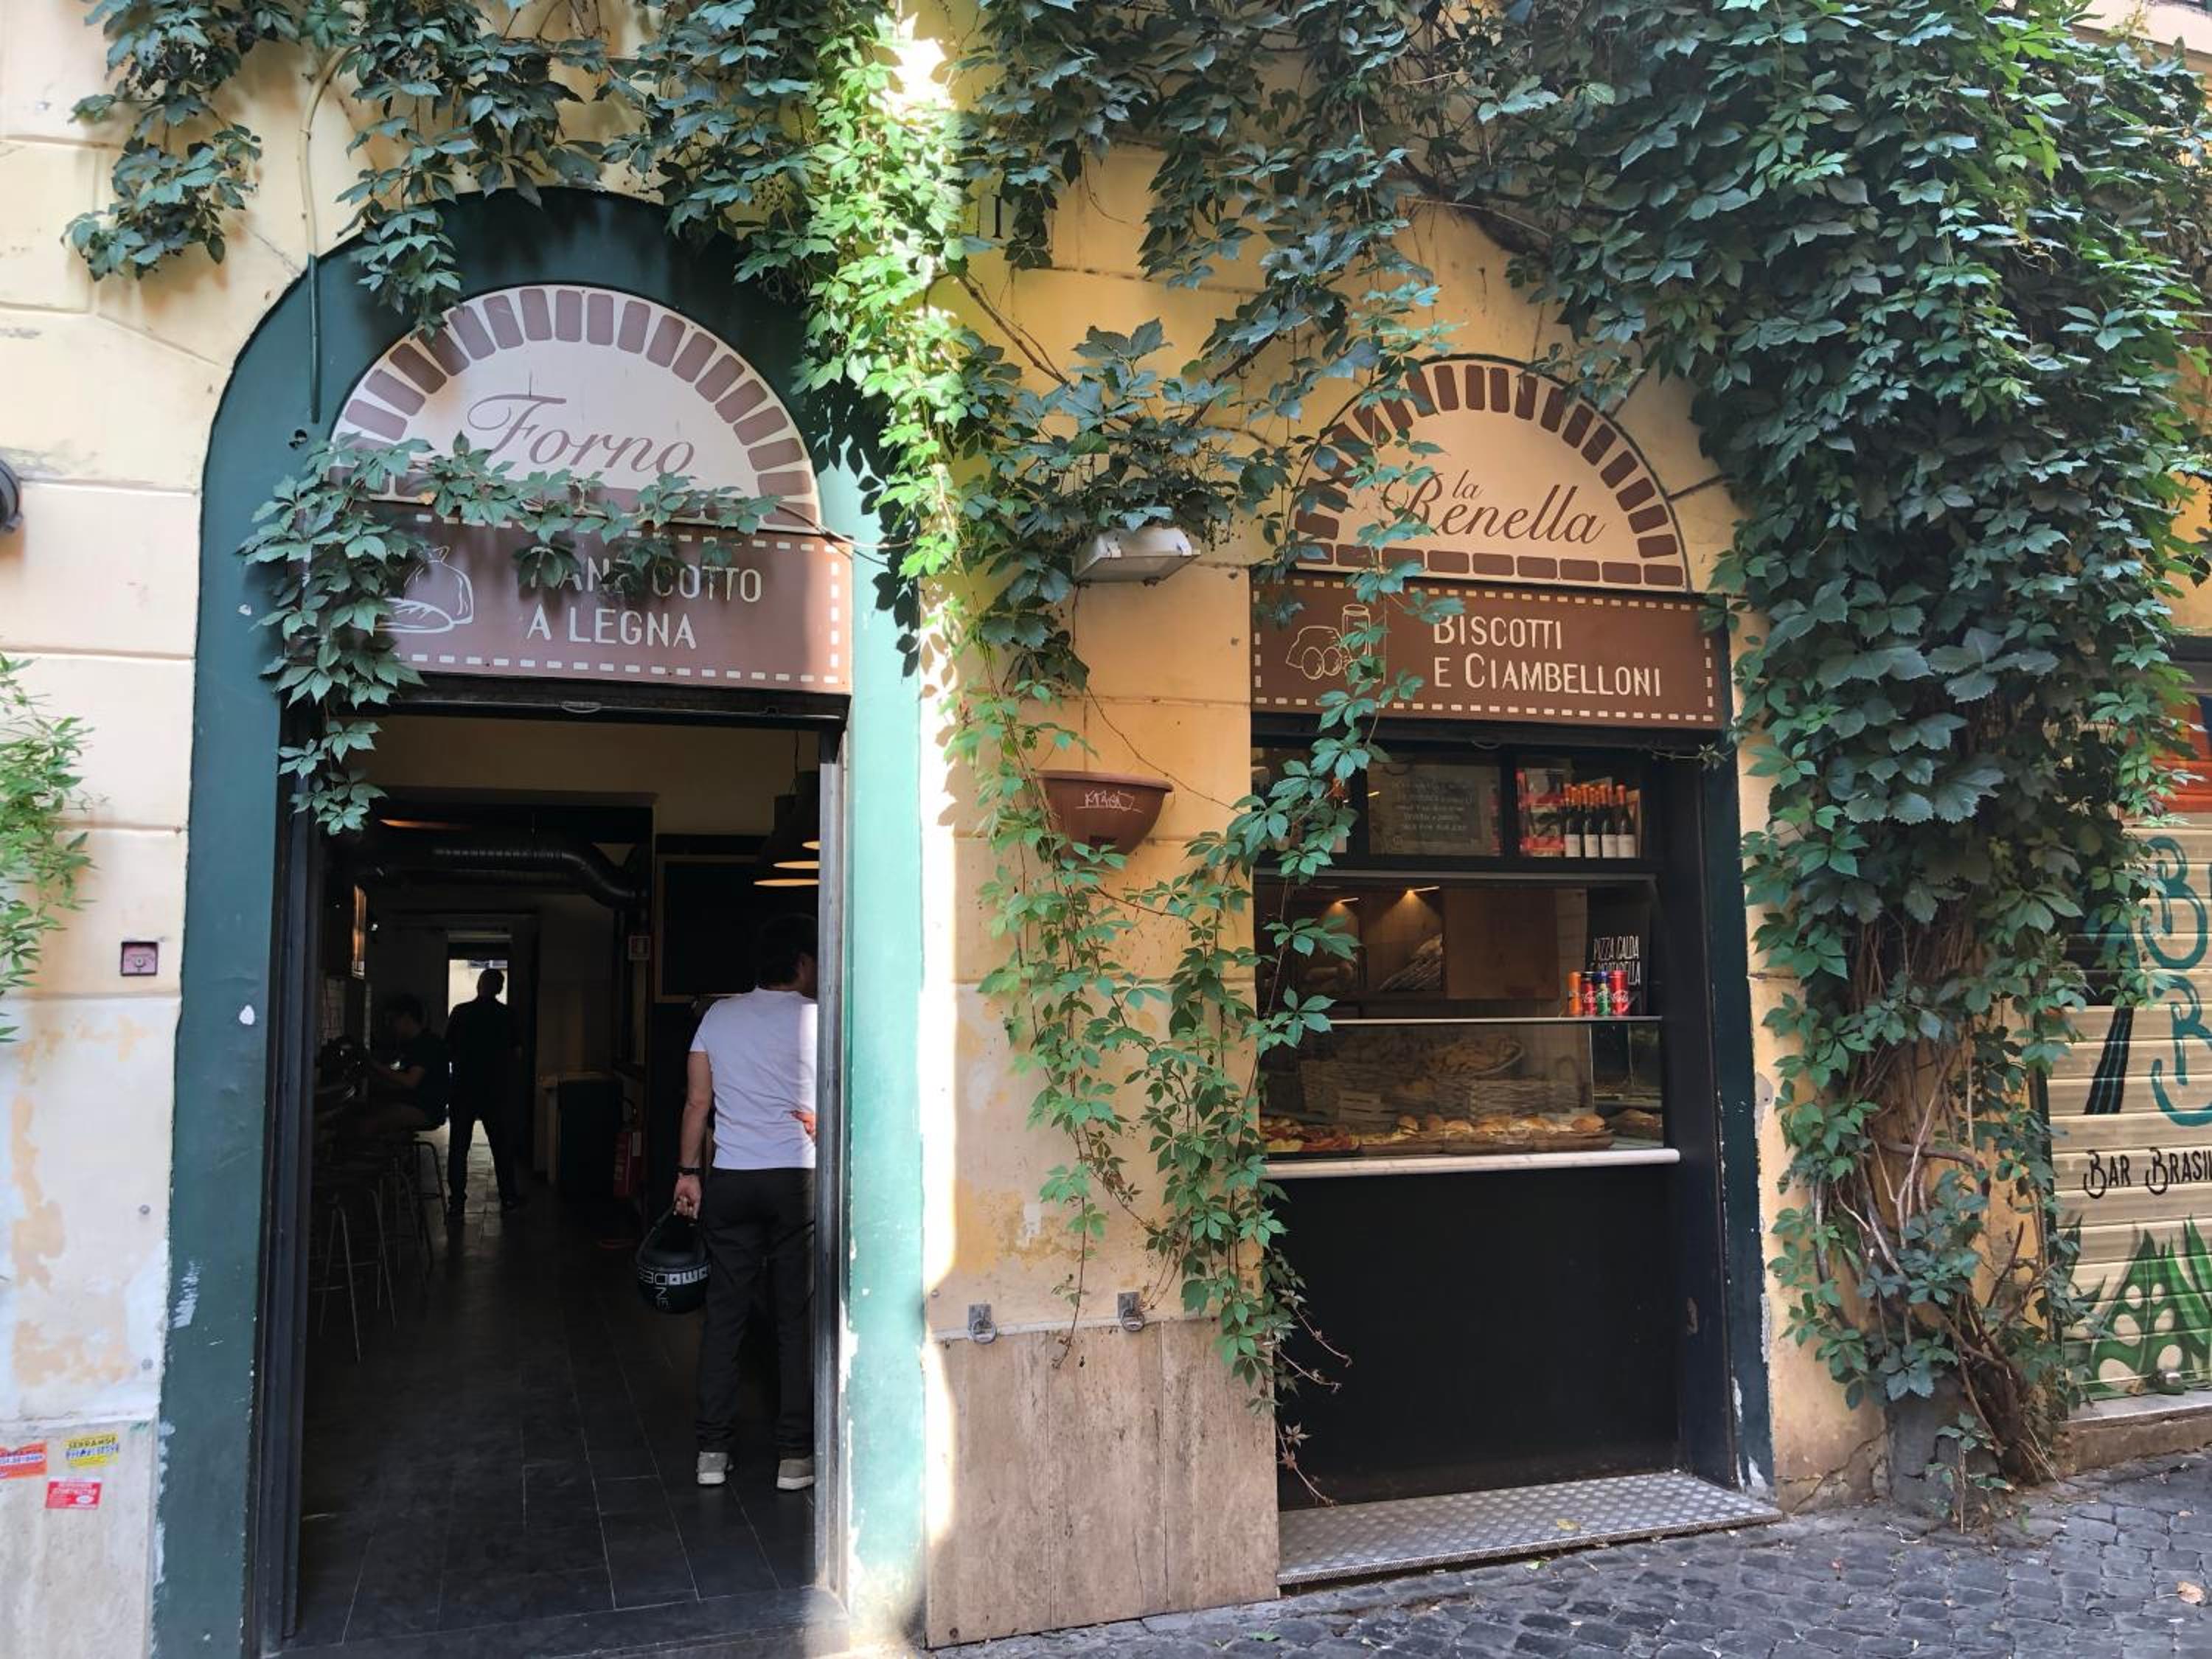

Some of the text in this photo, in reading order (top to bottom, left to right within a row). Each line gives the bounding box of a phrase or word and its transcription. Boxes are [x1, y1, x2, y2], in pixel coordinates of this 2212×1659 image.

[467, 394, 695, 473] Forno
[1452, 470, 1484, 500] la
[526, 604, 697, 650] A LEGNA
[1433, 615, 1562, 650] BISCOTTI
[1434, 653, 1660, 697] E CIAMBELLONI
[2084, 1150, 2132, 1199] BAR
